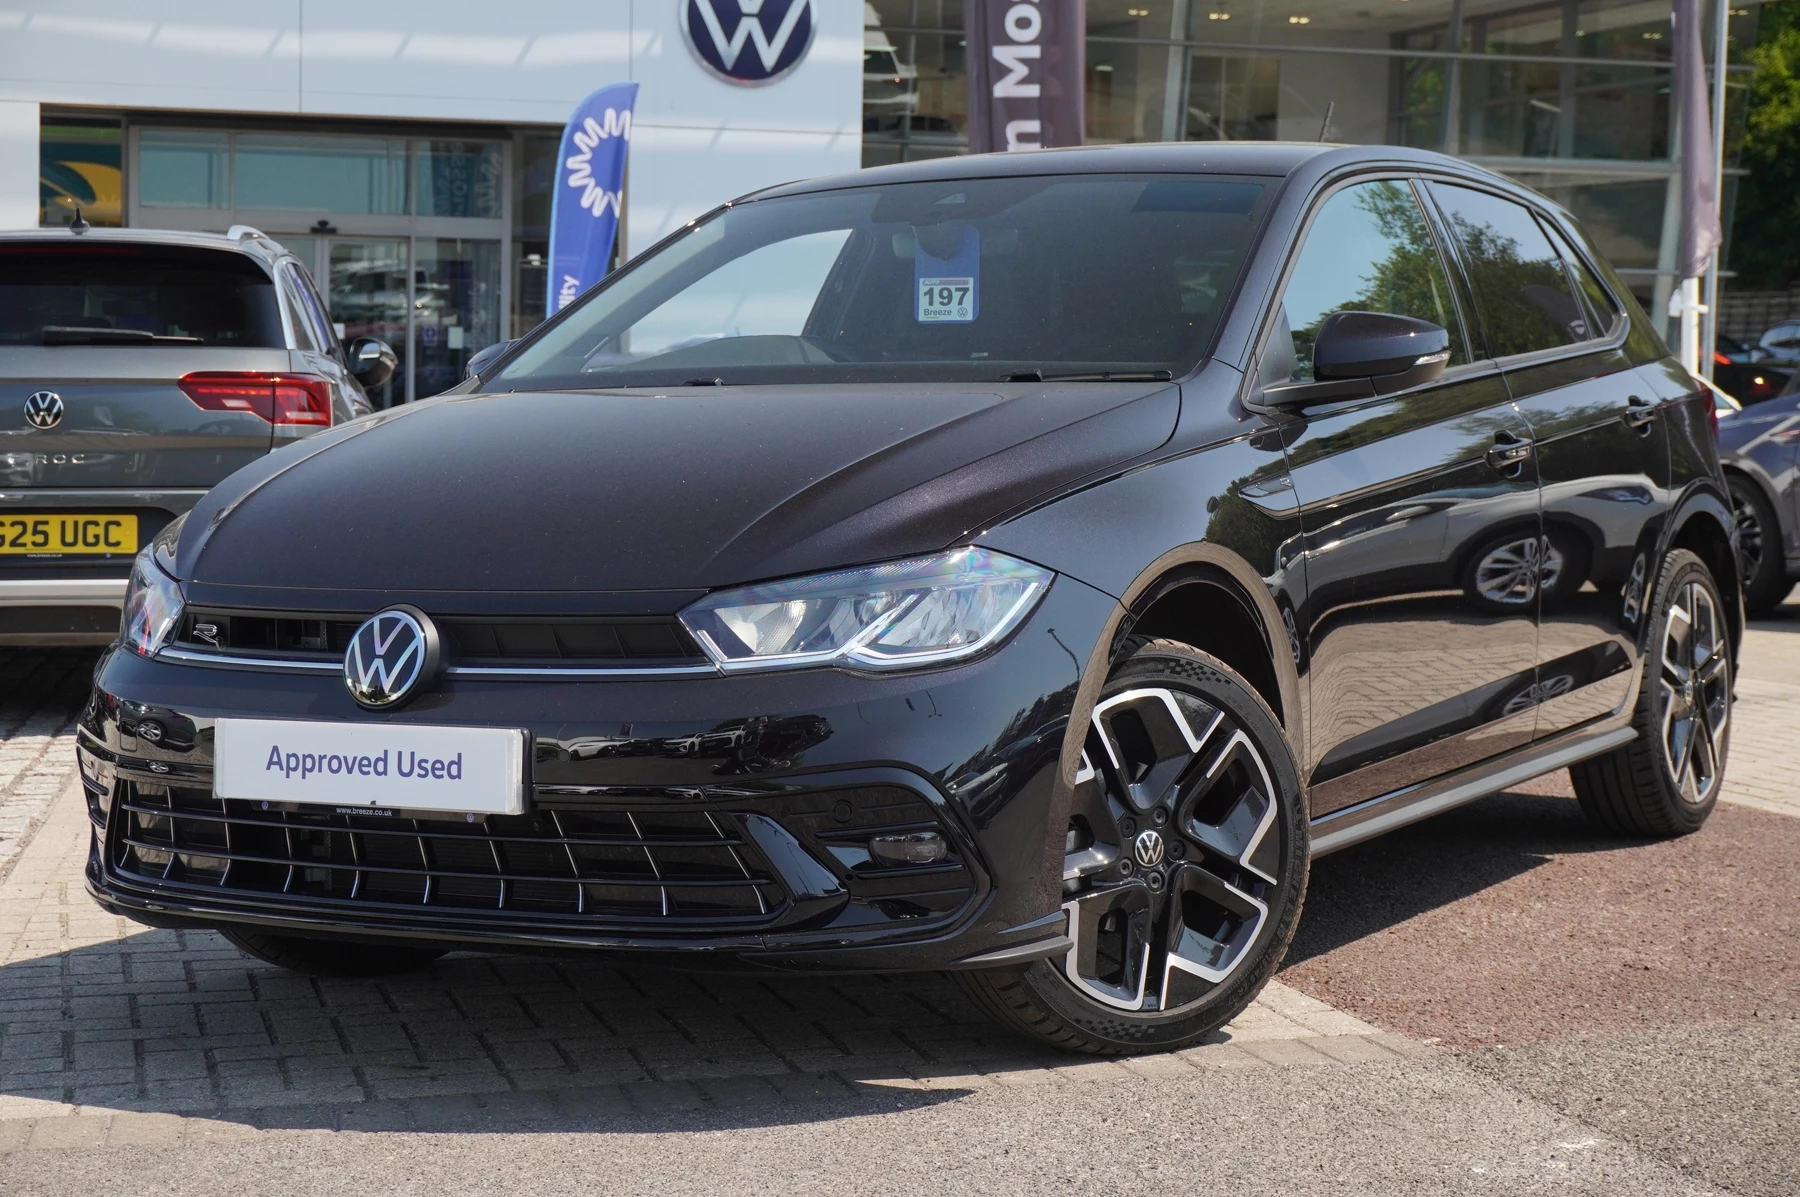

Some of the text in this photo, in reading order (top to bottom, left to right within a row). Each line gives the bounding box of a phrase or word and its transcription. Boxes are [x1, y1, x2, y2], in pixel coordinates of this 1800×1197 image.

[992, 0, 1042, 98] Mo
[923, 287, 970, 306] 197
[923, 308, 952, 316] Breeze
[26, 391, 62, 426] VW
[60, 520, 122, 547] UGC
[349, 615, 421, 697] VW
[265, 745, 463, 780] Approved Used
[335, 807, 393, 817] www.breeze.co.uk
[1136, 832, 1163, 864] VW
